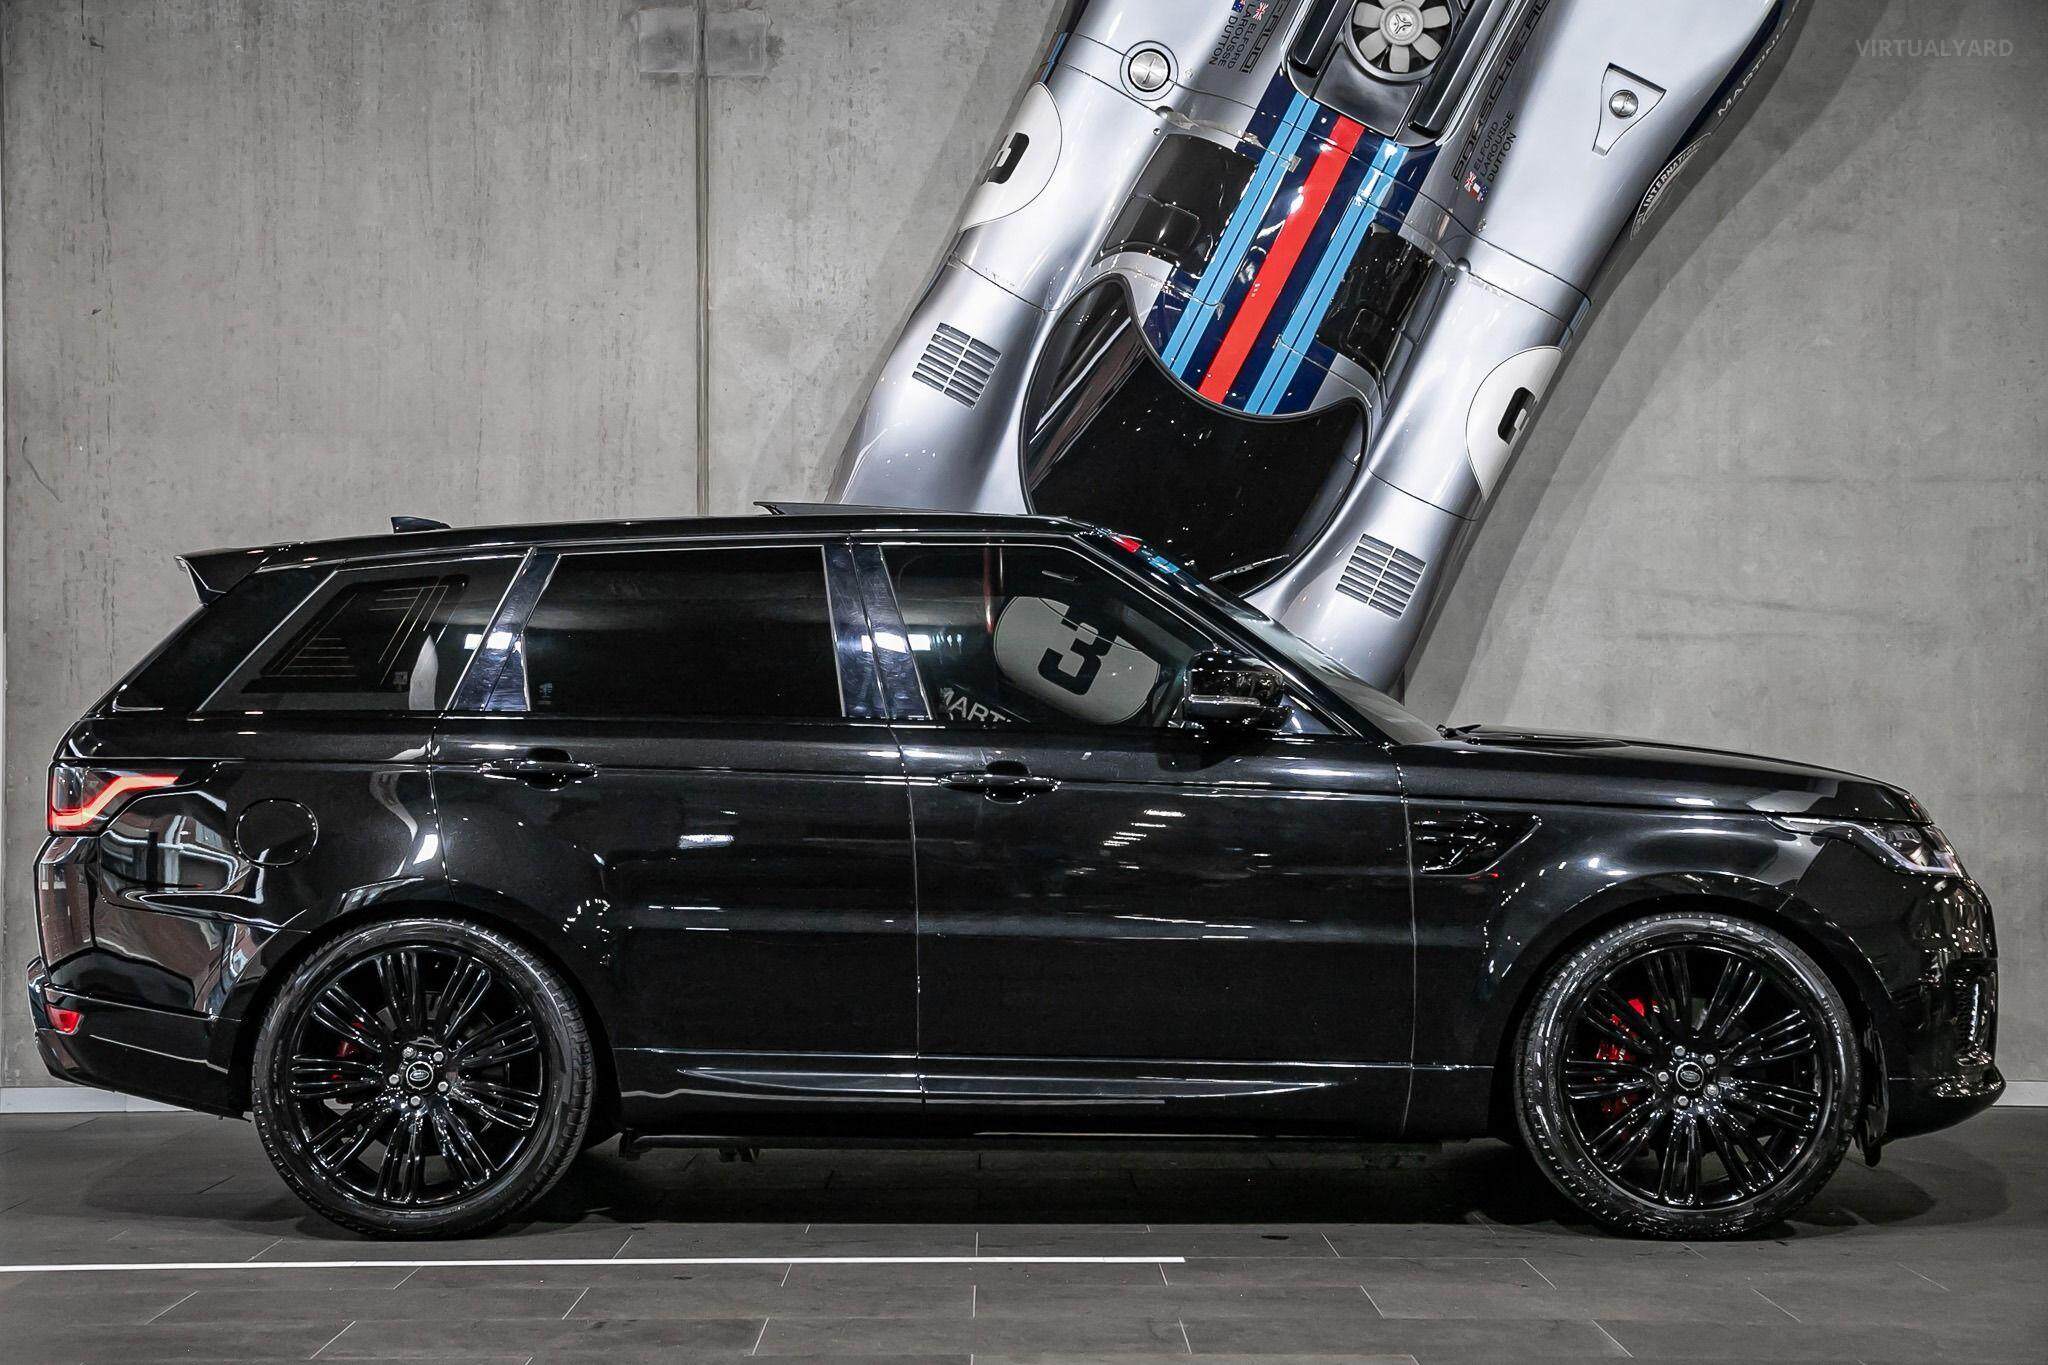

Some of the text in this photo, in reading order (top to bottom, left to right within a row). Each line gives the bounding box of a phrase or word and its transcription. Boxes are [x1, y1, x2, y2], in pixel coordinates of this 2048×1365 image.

[1208, 15, 1239, 66] DUTTON
[1217, 3, 1256, 67] LAROUSSE
[1227, 23, 1257, 69] ELFORD
[1472, 121, 1499, 172] ELFORD
[1480, 109, 1516, 177] LAROUSSE
[1486, 131, 1517, 183] DUTTON
[942, 687, 1012, 723] MART
